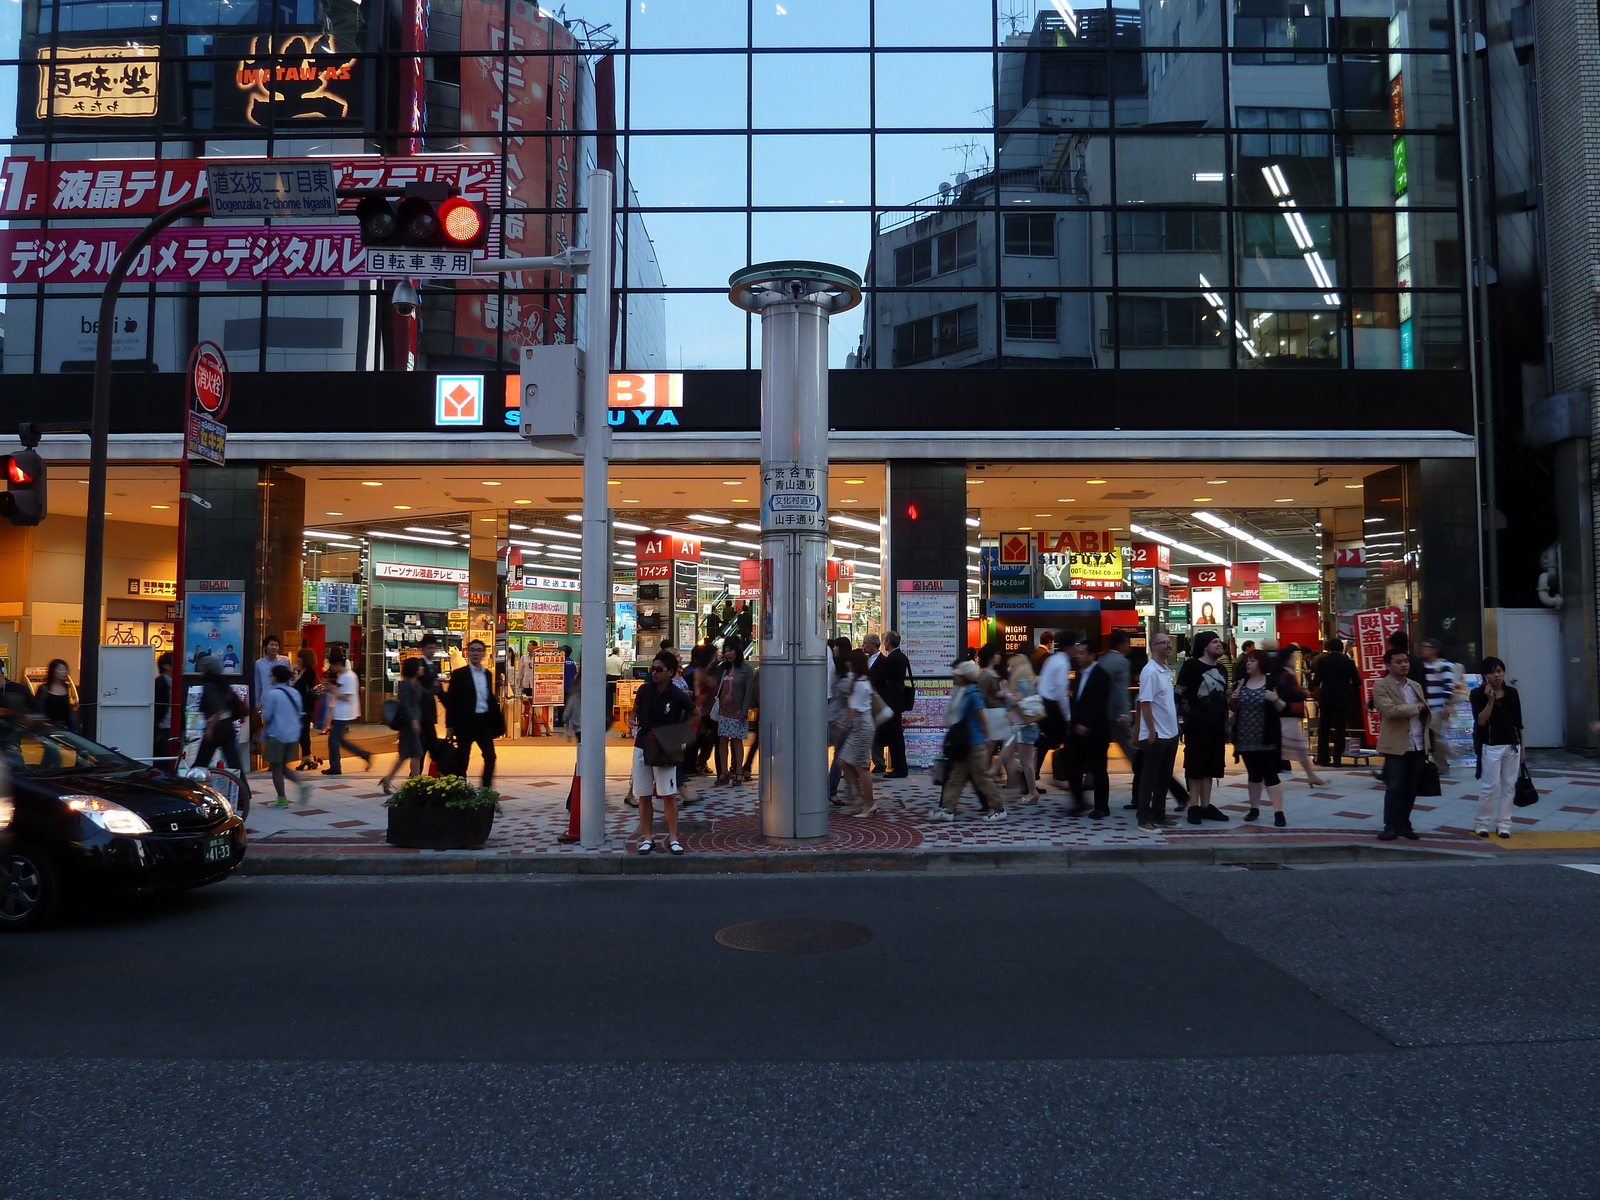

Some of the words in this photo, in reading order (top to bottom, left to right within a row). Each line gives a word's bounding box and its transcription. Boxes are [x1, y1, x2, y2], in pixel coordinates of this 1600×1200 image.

[213, 169, 329, 194] 道玄坂二丁目東
[215, 198, 262, 211] Dogenzaka
[263, 198, 302, 210] 2-chome
[303, 197, 332, 210] higashi
[372, 253, 467, 271] 自転車専用
[198, 365, 221, 398] 消火栓
[504, 409, 679, 425] SUYA
[200, 428, 225, 453] セキネ
[775, 467, 815, 479] 渋谷駅
[775, 480, 815, 491] 青山通り
[775, 496, 815, 506] 文化村通り
[775, 514, 815, 526] 山手通り
[645, 540, 663, 554] A1
[681, 541, 694, 555] A1
[1037, 531, 1115, 553] LABI
[384, 565, 453, 580] パーソナル液晶テレビ
[639, 565, 669, 577] 17インチ
[1198, 571, 1217, 582] C2
[990, 600, 1035, 609] Panasonic
[1005, 625, 1027, 633] NIGHT
[1005, 634, 1028, 642] COLOR
